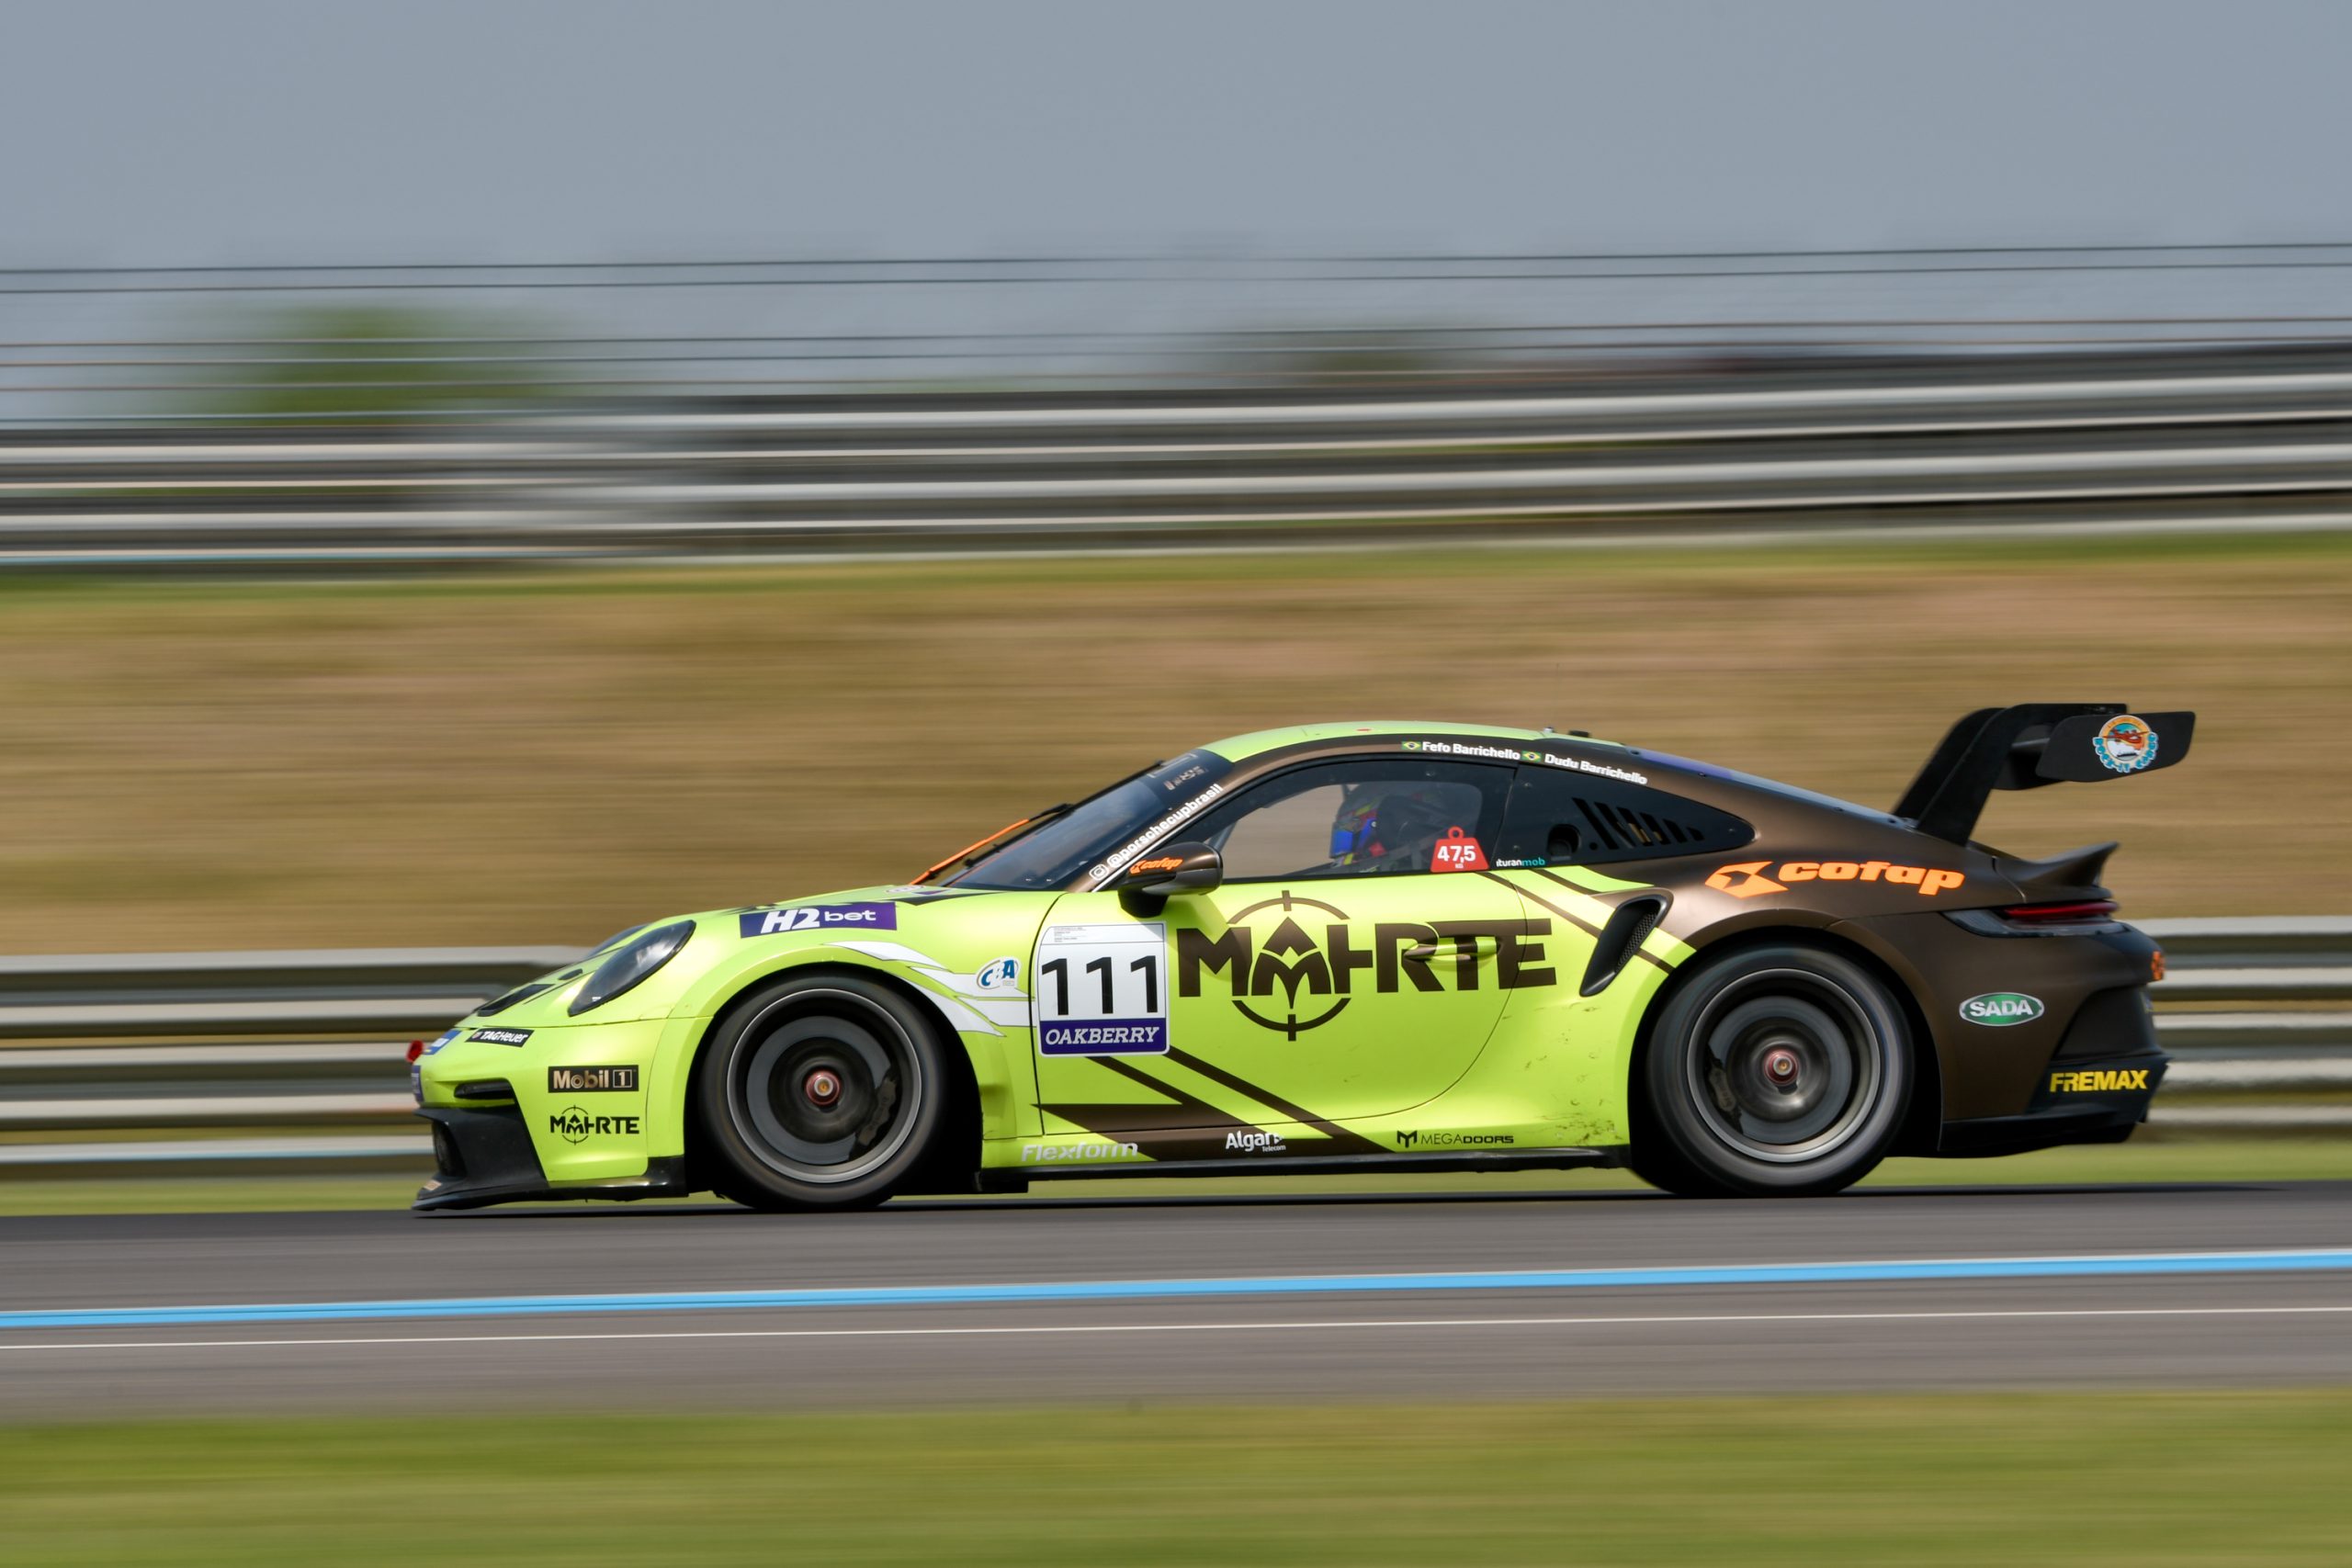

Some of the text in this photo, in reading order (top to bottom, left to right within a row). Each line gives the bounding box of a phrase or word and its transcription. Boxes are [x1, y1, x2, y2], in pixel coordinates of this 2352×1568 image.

[1422, 741, 1521, 761] Fefo Barrichello
[1544, 753, 1648, 785] Dudu Barrichello
[1105, 783, 1224, 868] @porschecupbrasil
[1437, 845, 1476, 863] 47,5
[1778, 861, 1965, 896] cofap
[1041, 955, 1158, 1016] 111
[1969, 1000, 2034, 1018] SADA
[1045, 1026, 1159, 1045] OAKBERRY
[553, 1069, 610, 1089] Mobil
[2050, 1069, 2150, 1093] FREMAX
[549, 1113, 640, 1137] MAHRTE
[1021, 1142, 1138, 1162] Flexform
[1225, 1130, 1278, 1153] Algar
